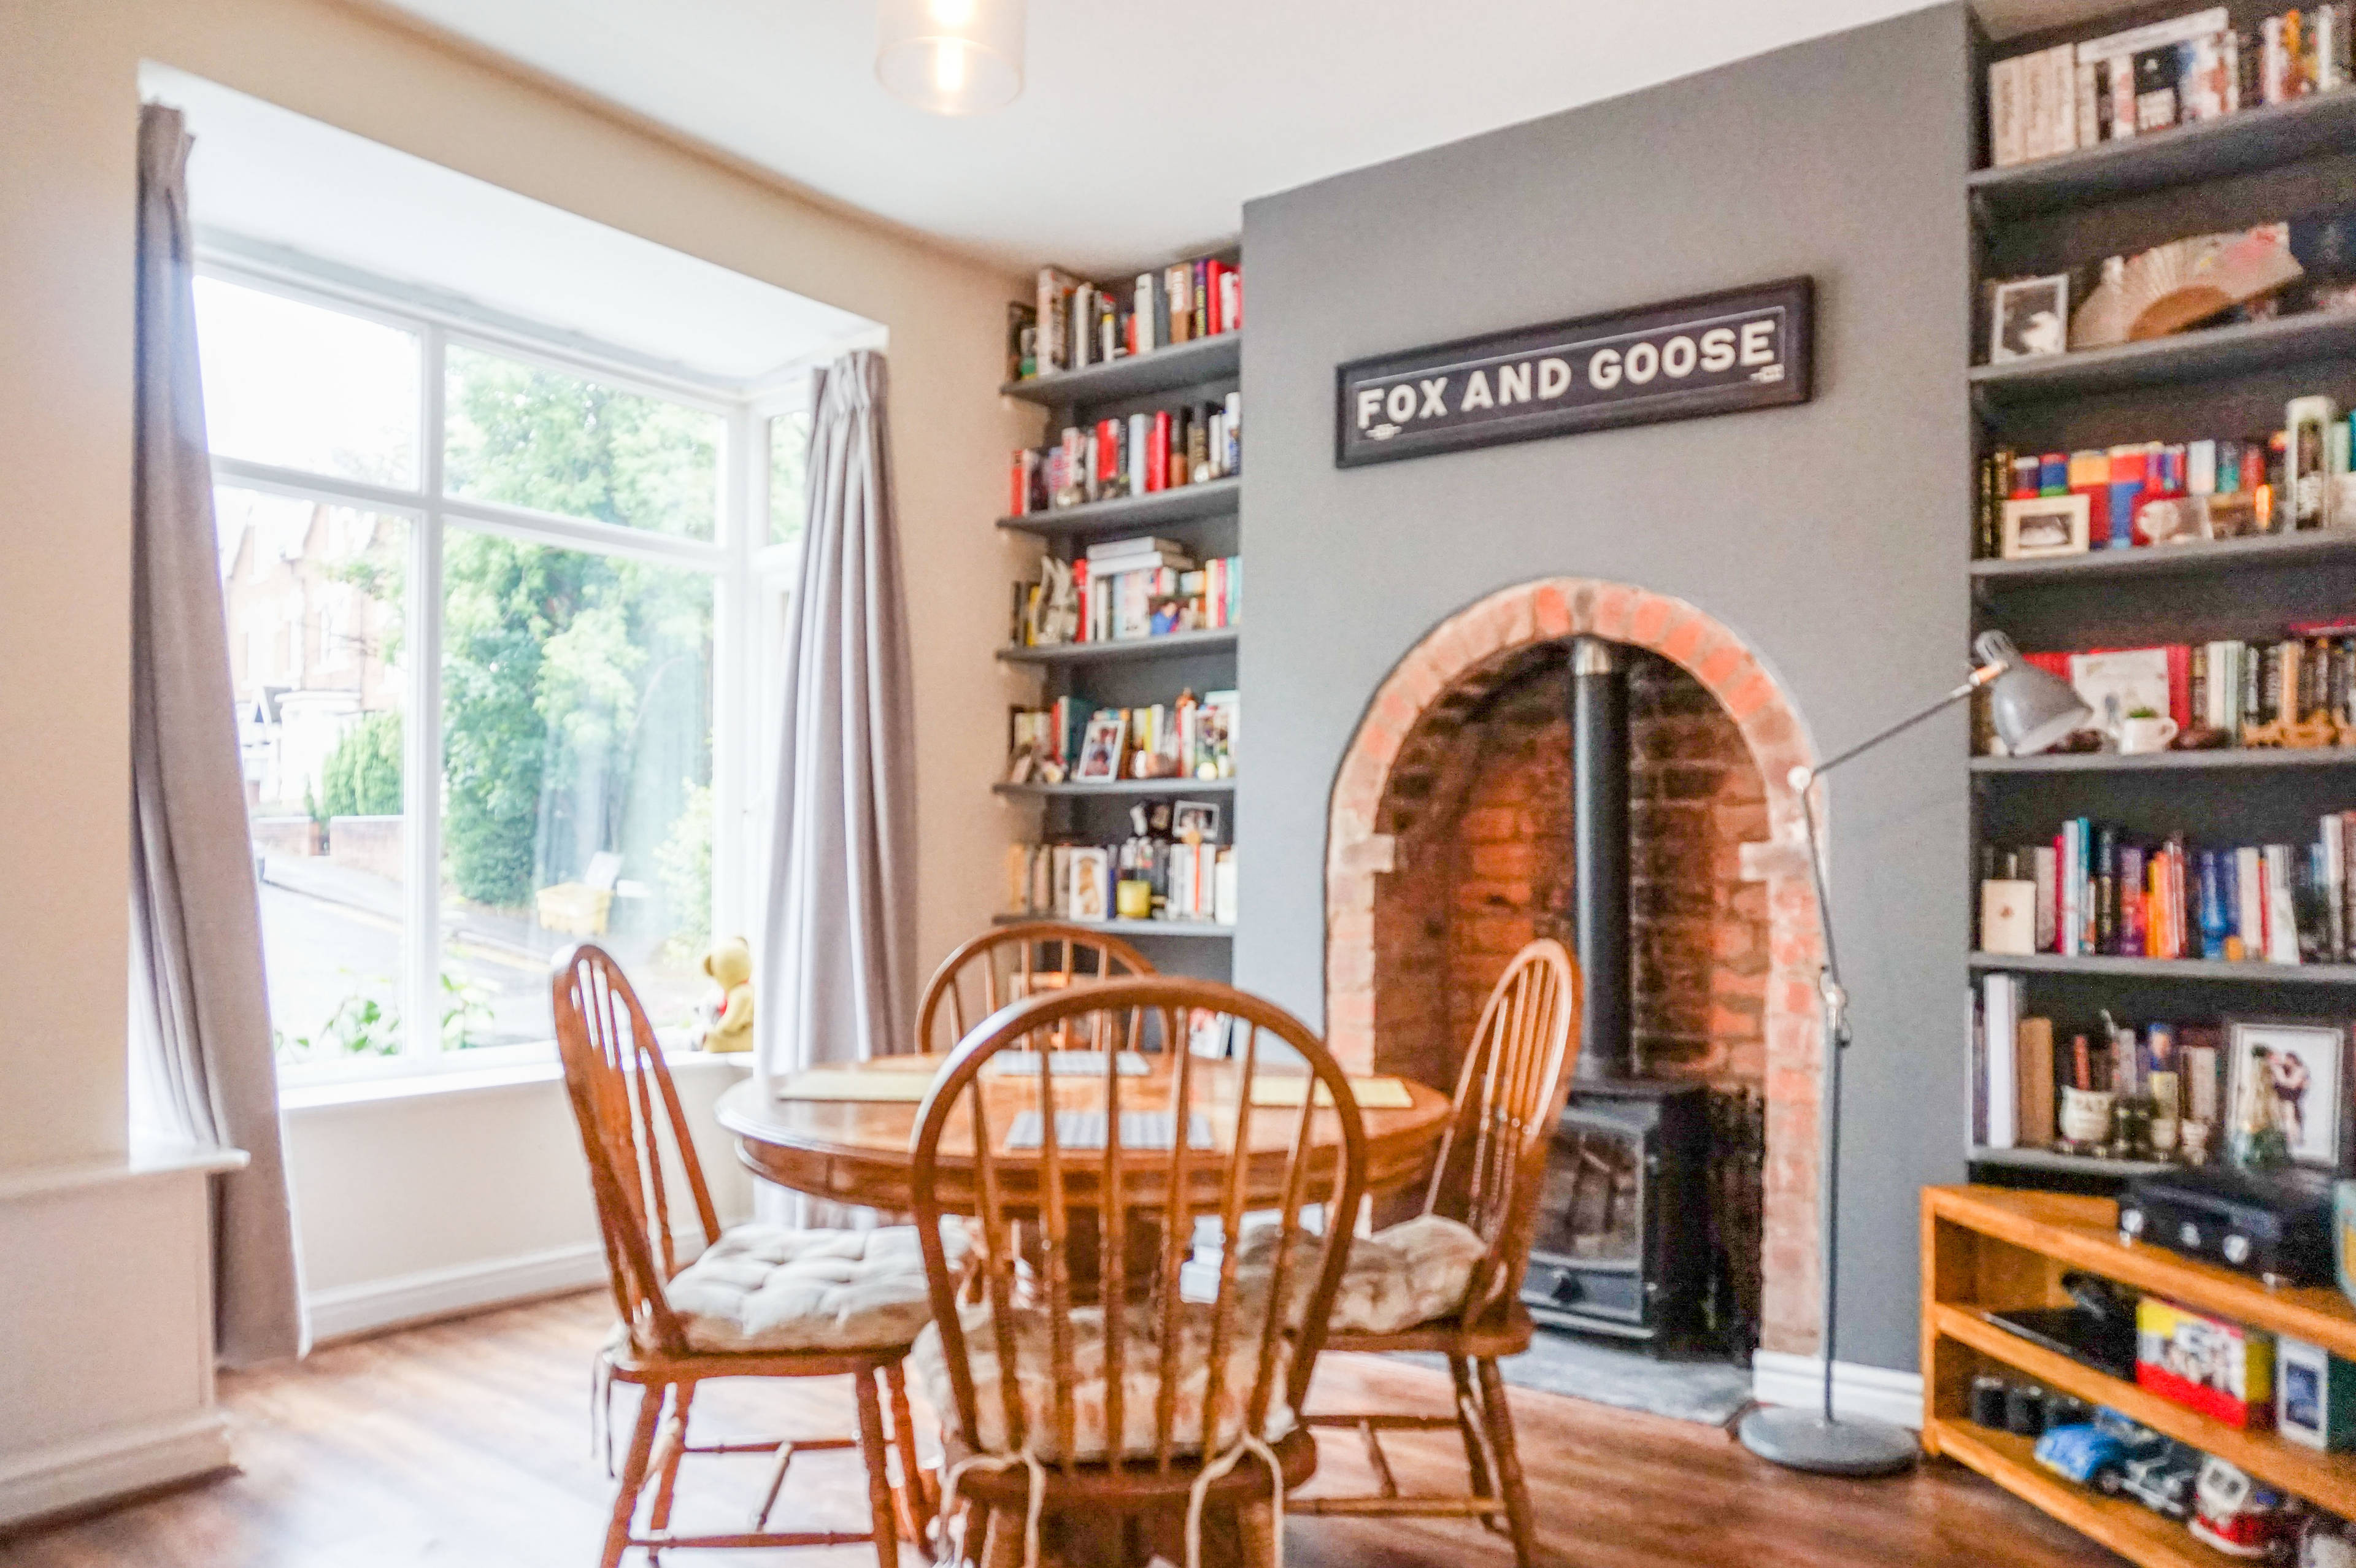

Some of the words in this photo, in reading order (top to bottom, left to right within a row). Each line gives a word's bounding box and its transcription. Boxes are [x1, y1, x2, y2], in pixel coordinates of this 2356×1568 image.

[1357, 376, 1449, 430] FOX
[1461, 357, 1572, 412] AND
[1588, 319, 1776, 390] GOOSE
